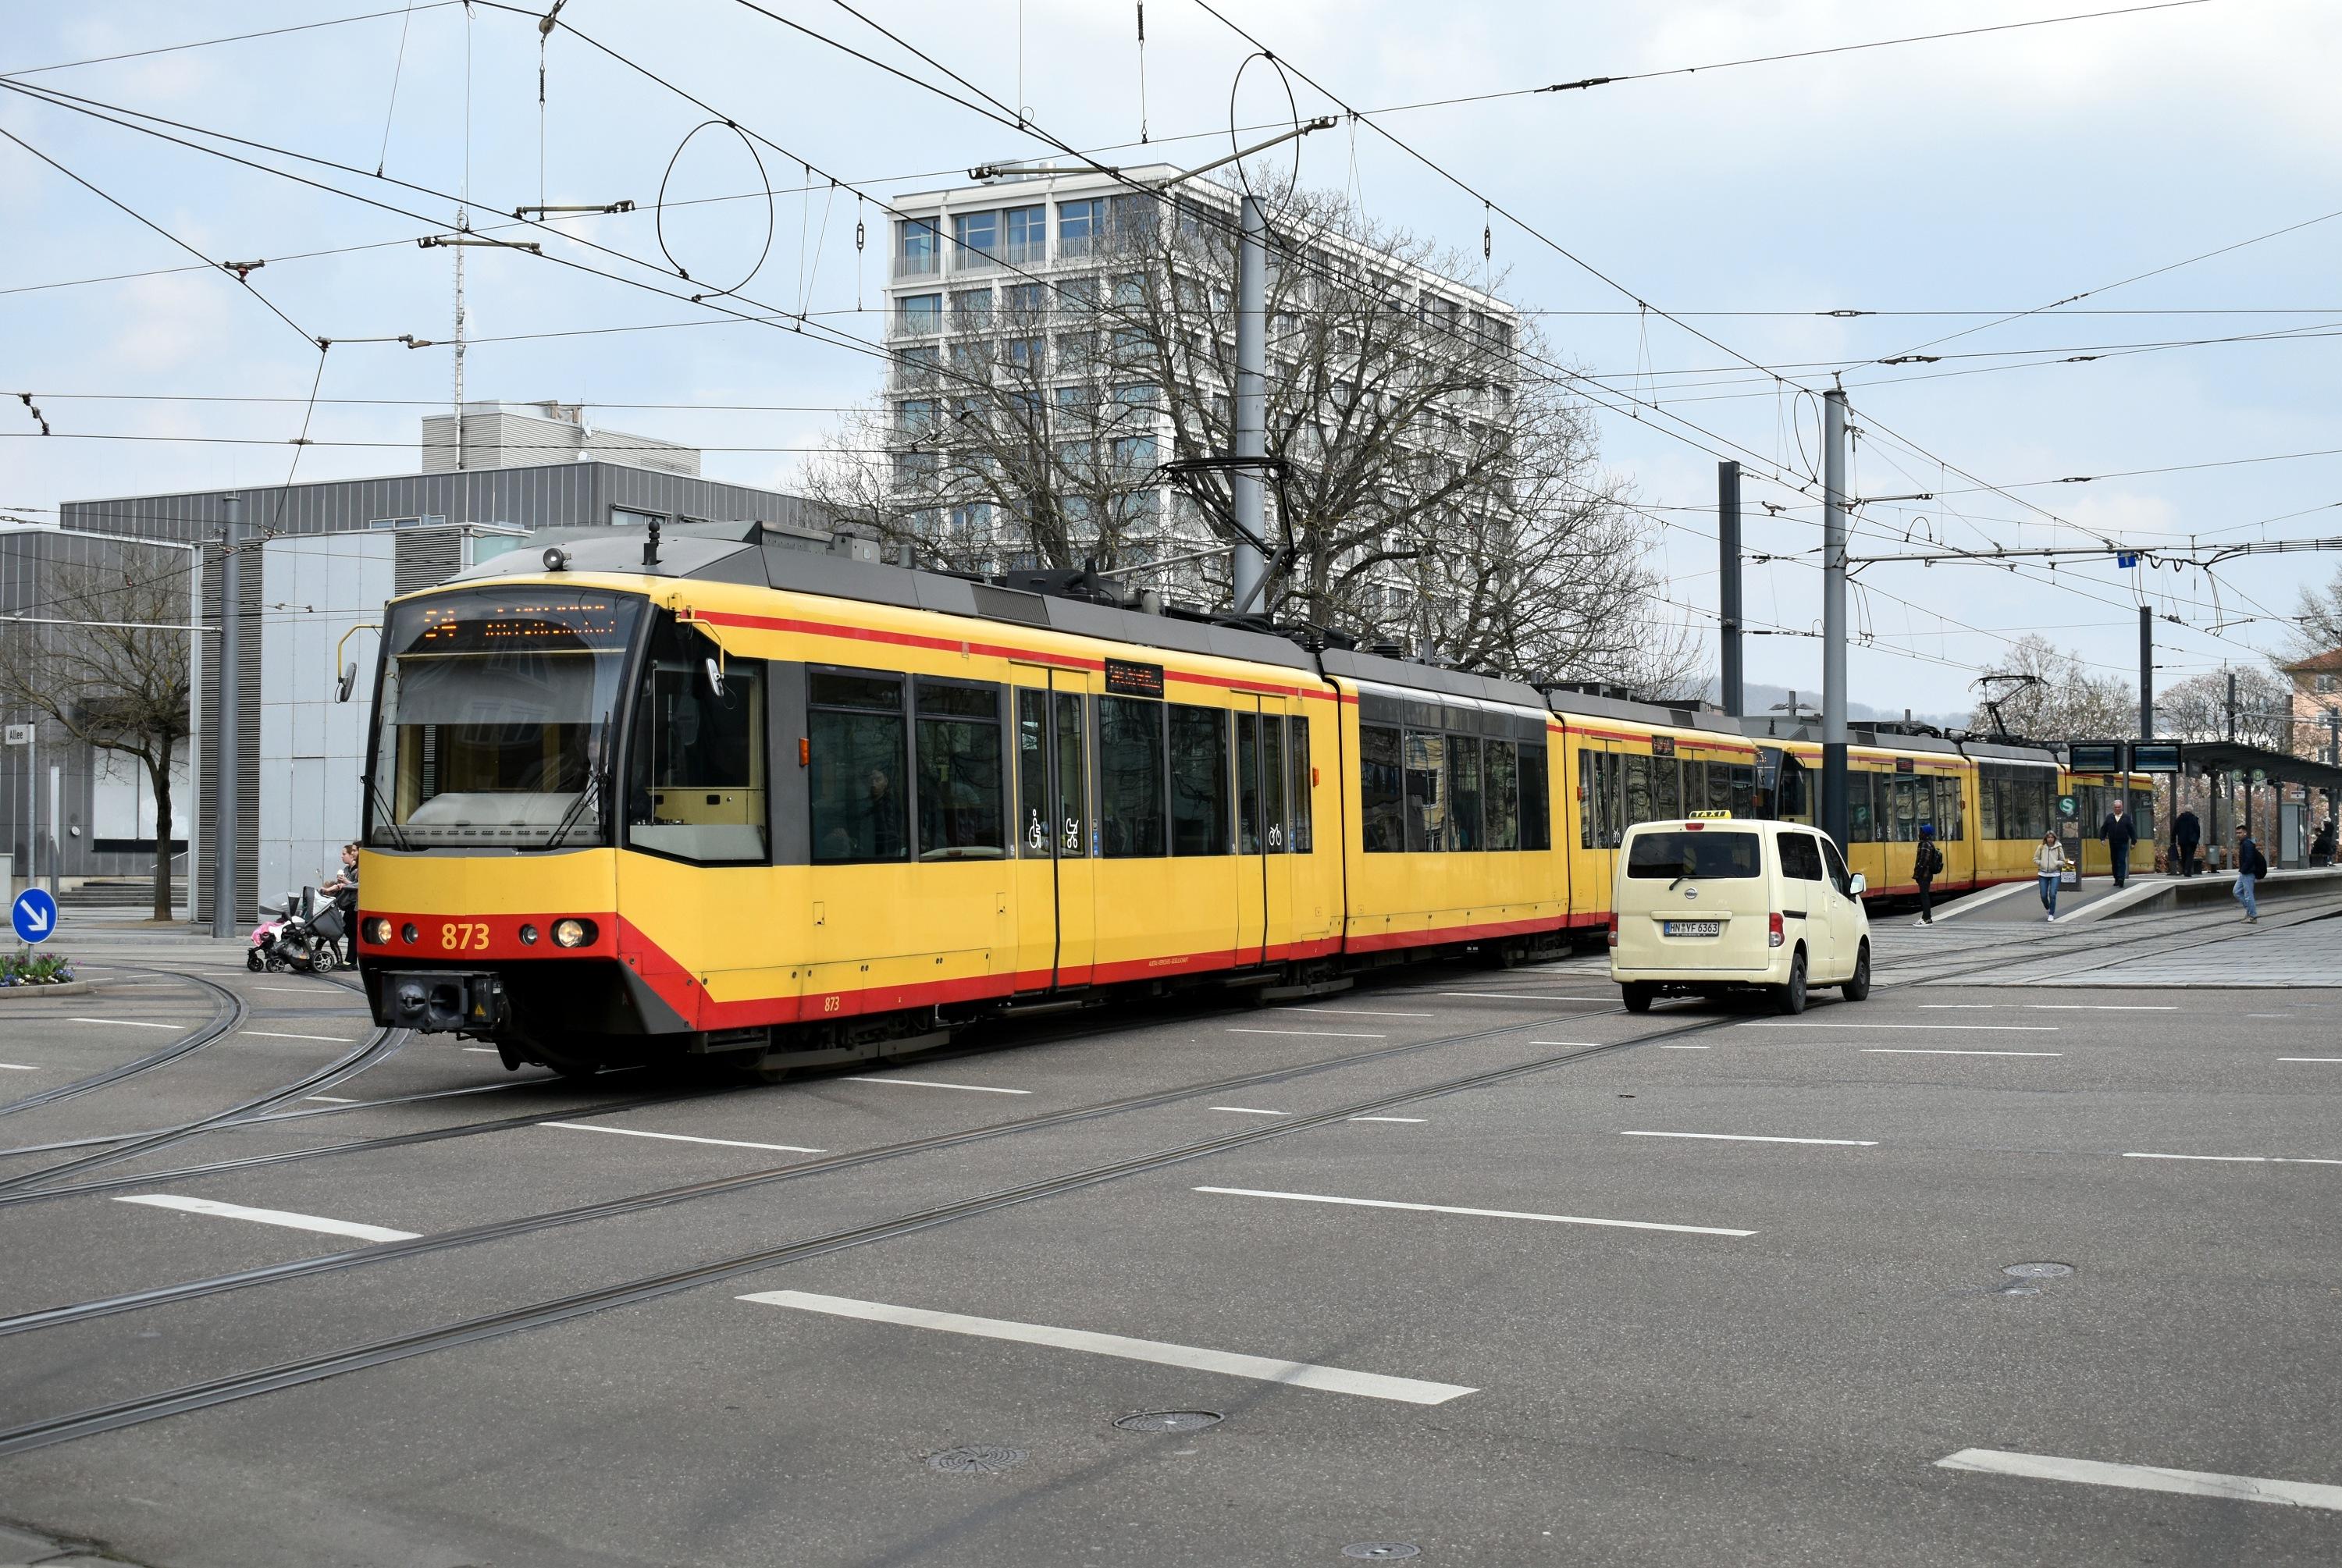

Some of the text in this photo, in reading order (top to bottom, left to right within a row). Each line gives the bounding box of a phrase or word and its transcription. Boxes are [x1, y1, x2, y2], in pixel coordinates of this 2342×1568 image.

[9, 730, 23, 740] Allee
[2063, 798, 2073, 812] S
[1670, 923, 1717, 933] HN YF 6363
[442, 923, 489, 950] 873
[824, 996, 840, 1012] 873
